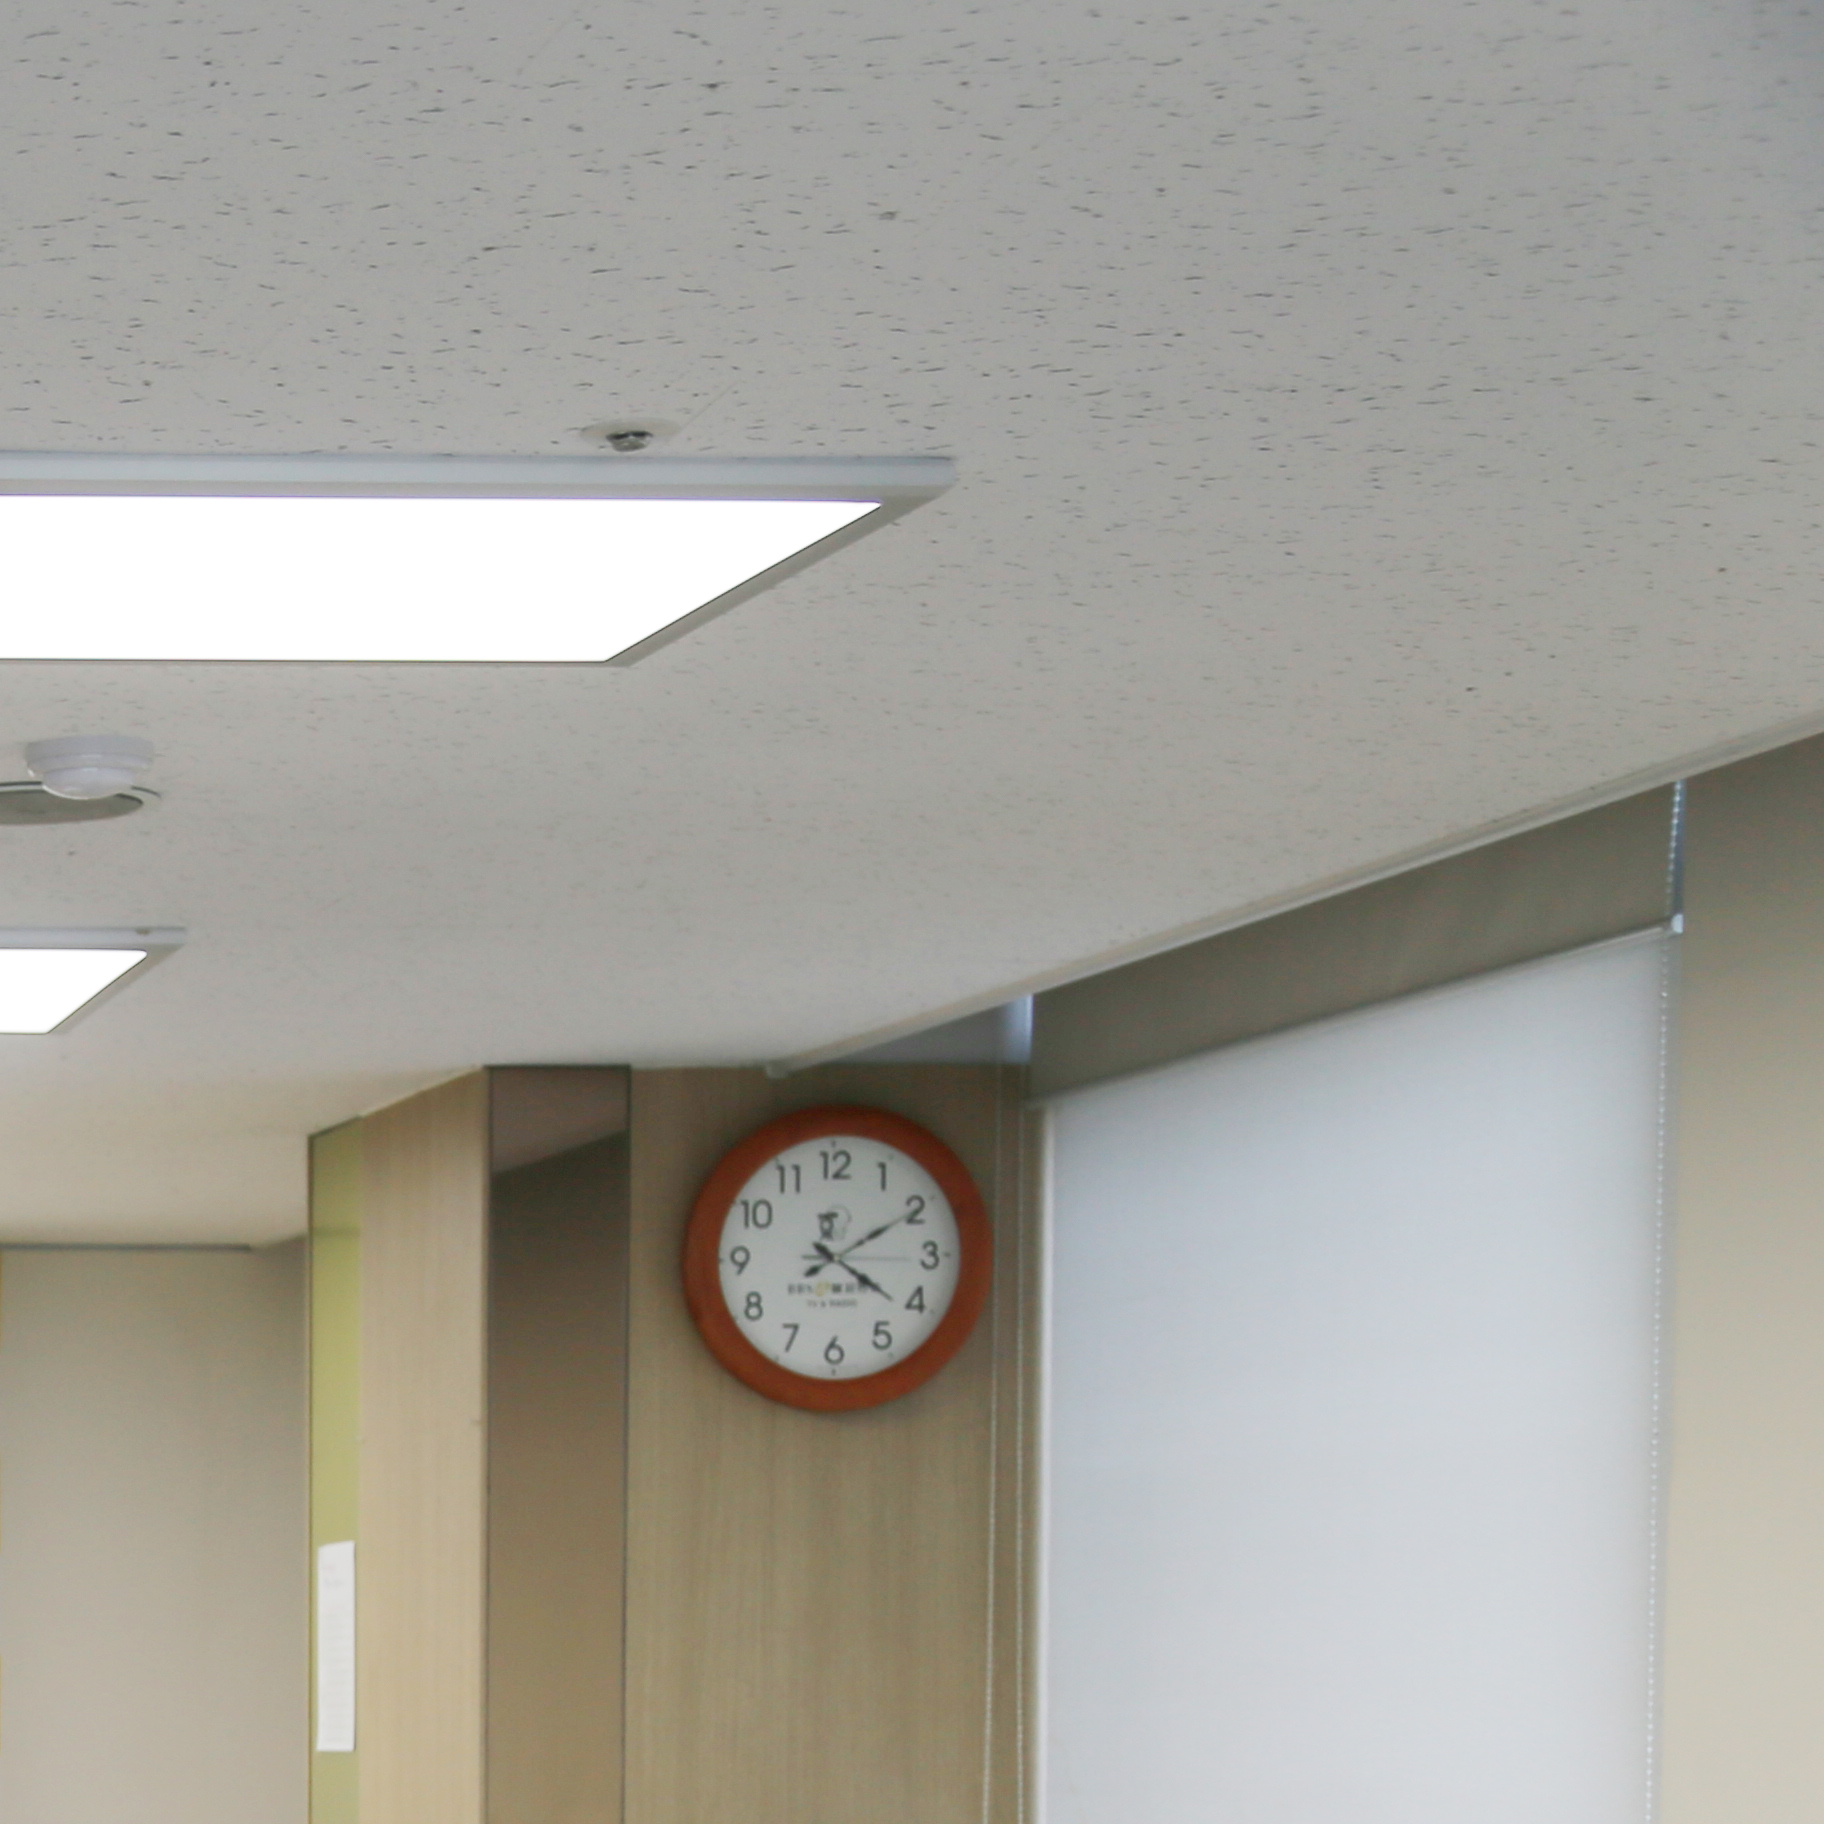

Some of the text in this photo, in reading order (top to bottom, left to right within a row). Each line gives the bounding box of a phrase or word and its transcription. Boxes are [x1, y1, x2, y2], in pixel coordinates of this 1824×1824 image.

[777, 1164, 801, 1194] 11
[819, 1150, 852, 1180] 12
[877, 1162, 887, 1191] 1
[741, 1199, 773, 1229] 10
[905, 1195, 925, 1225] 2
[730, 1246, 750, 1275] 9
[920, 1241, 940, 1270] 3
[744, 1292, 763, 1321] 8
[905, 1286, 925, 1314] 4
[782, 1323, 799, 1352] 7
[872, 1321, 892, 1350] 5
[824, 1336, 845, 1365] 6
